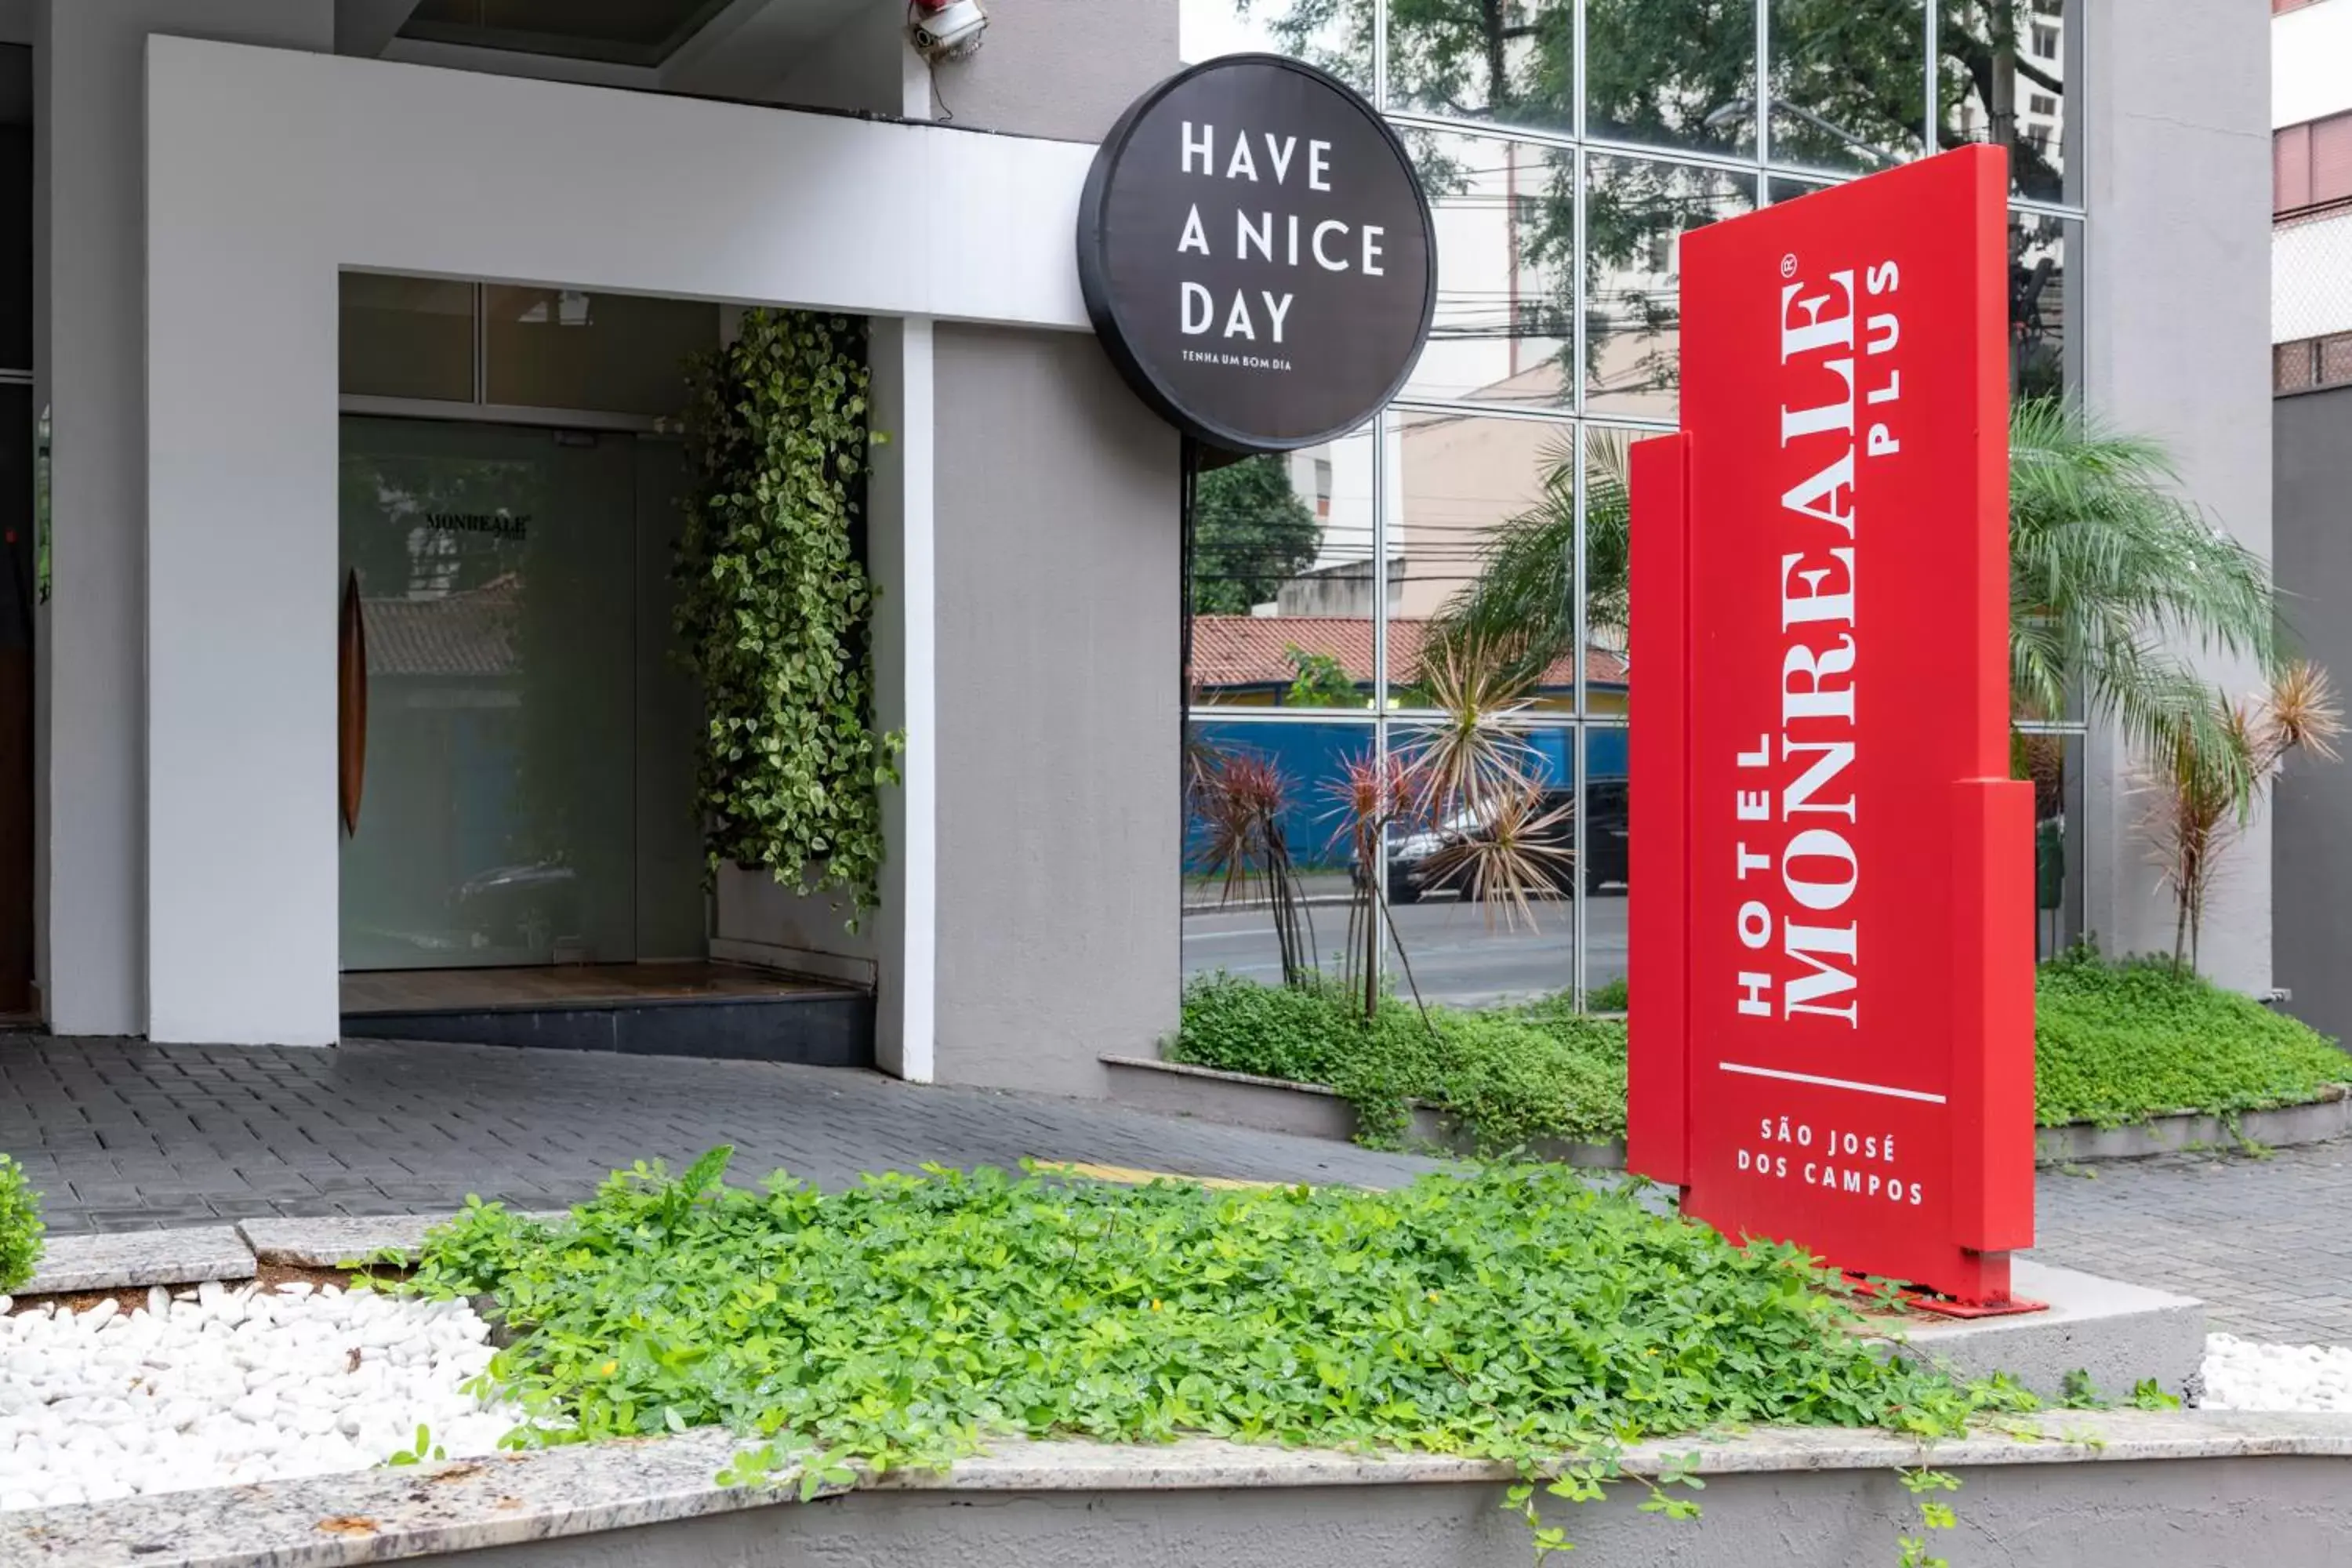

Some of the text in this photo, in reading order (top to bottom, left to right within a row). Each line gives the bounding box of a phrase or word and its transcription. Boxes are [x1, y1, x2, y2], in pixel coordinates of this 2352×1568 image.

[1181, 121, 1331, 192] HAVE
[1177, 203, 1385, 277] A NICE
[1181, 281, 1294, 343] DAY
[1182, 350, 1291, 372] TENHA UM BOM DIA
[1866, 260, 1900, 457] PLUS
[1737, 732, 1772, 1018] HOTEL
[1762, 1116, 1894, 1162] SÃO JOSÉ
[1738, 1149, 1922, 1206] DOS CAMPOS
